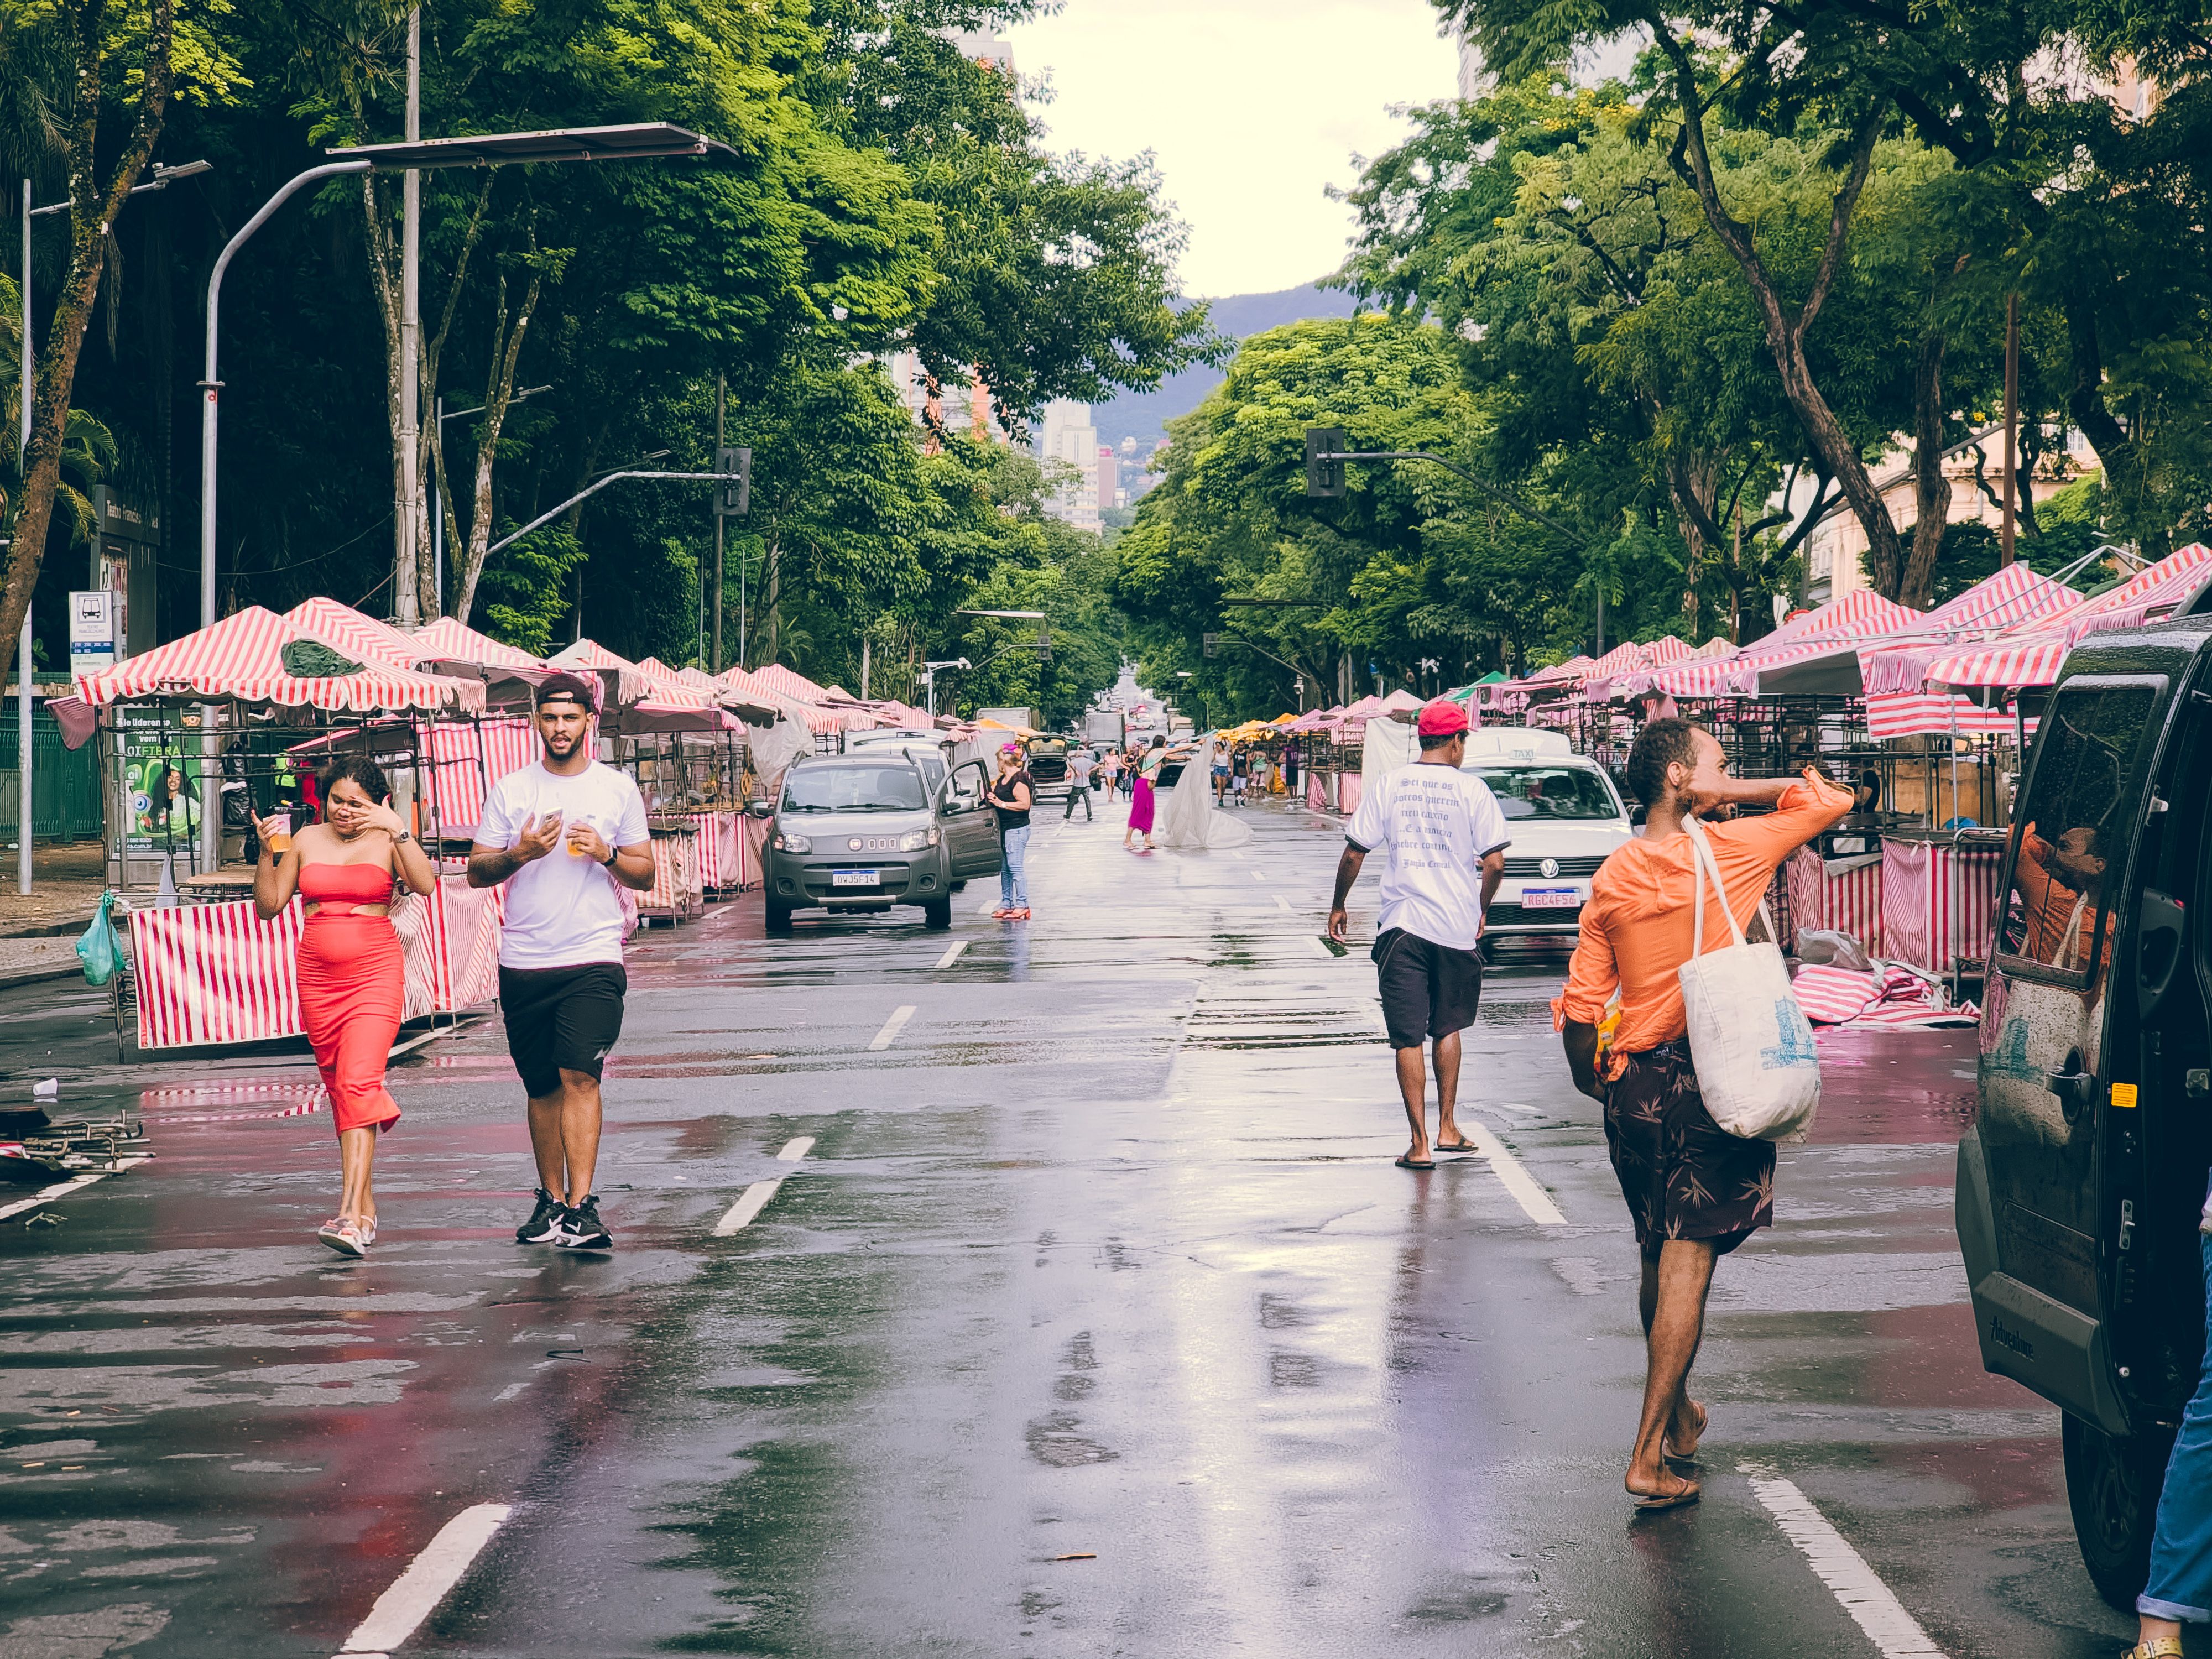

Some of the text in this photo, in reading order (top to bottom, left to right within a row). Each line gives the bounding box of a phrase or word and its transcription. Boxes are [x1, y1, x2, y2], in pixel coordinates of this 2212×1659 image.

[106, 499, 121, 519] Teatro
[1513, 749, 1533, 758] TAXI
[128, 769, 138, 779] oi
[1422, 780, 1438, 789] que
[1393, 794, 1459, 807] porcos querem
[1990, 1315, 2034, 1359] Adventure
